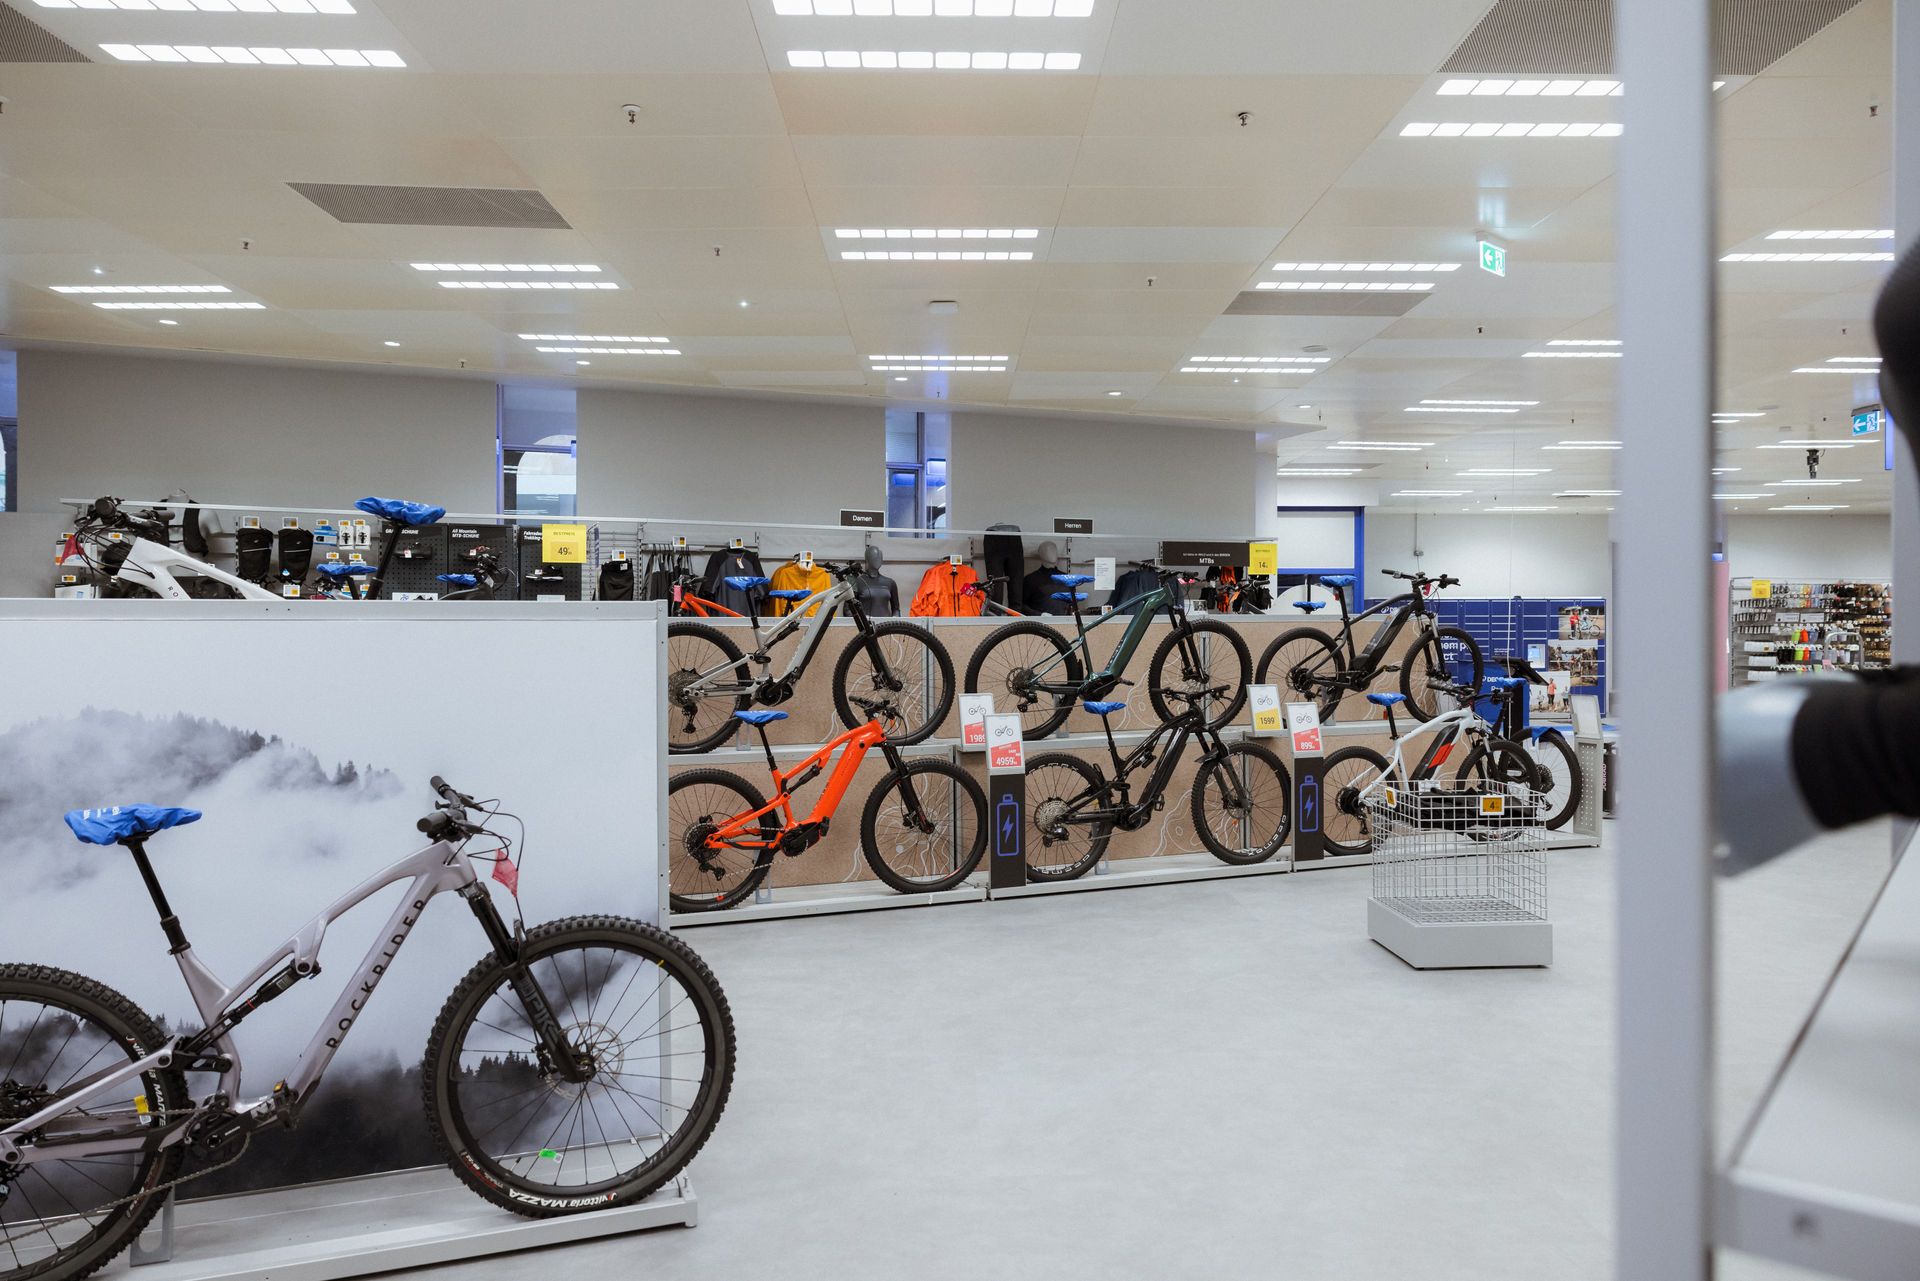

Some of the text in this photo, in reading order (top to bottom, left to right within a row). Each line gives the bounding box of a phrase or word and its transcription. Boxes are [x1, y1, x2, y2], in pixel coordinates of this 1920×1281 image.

[852, 514, 873, 522] Damen
[1260, 716, 1275, 725] 1599
[325, 899, 426, 1049] ROCKRIDER
[508, 1188, 568, 1208] MAZZA
